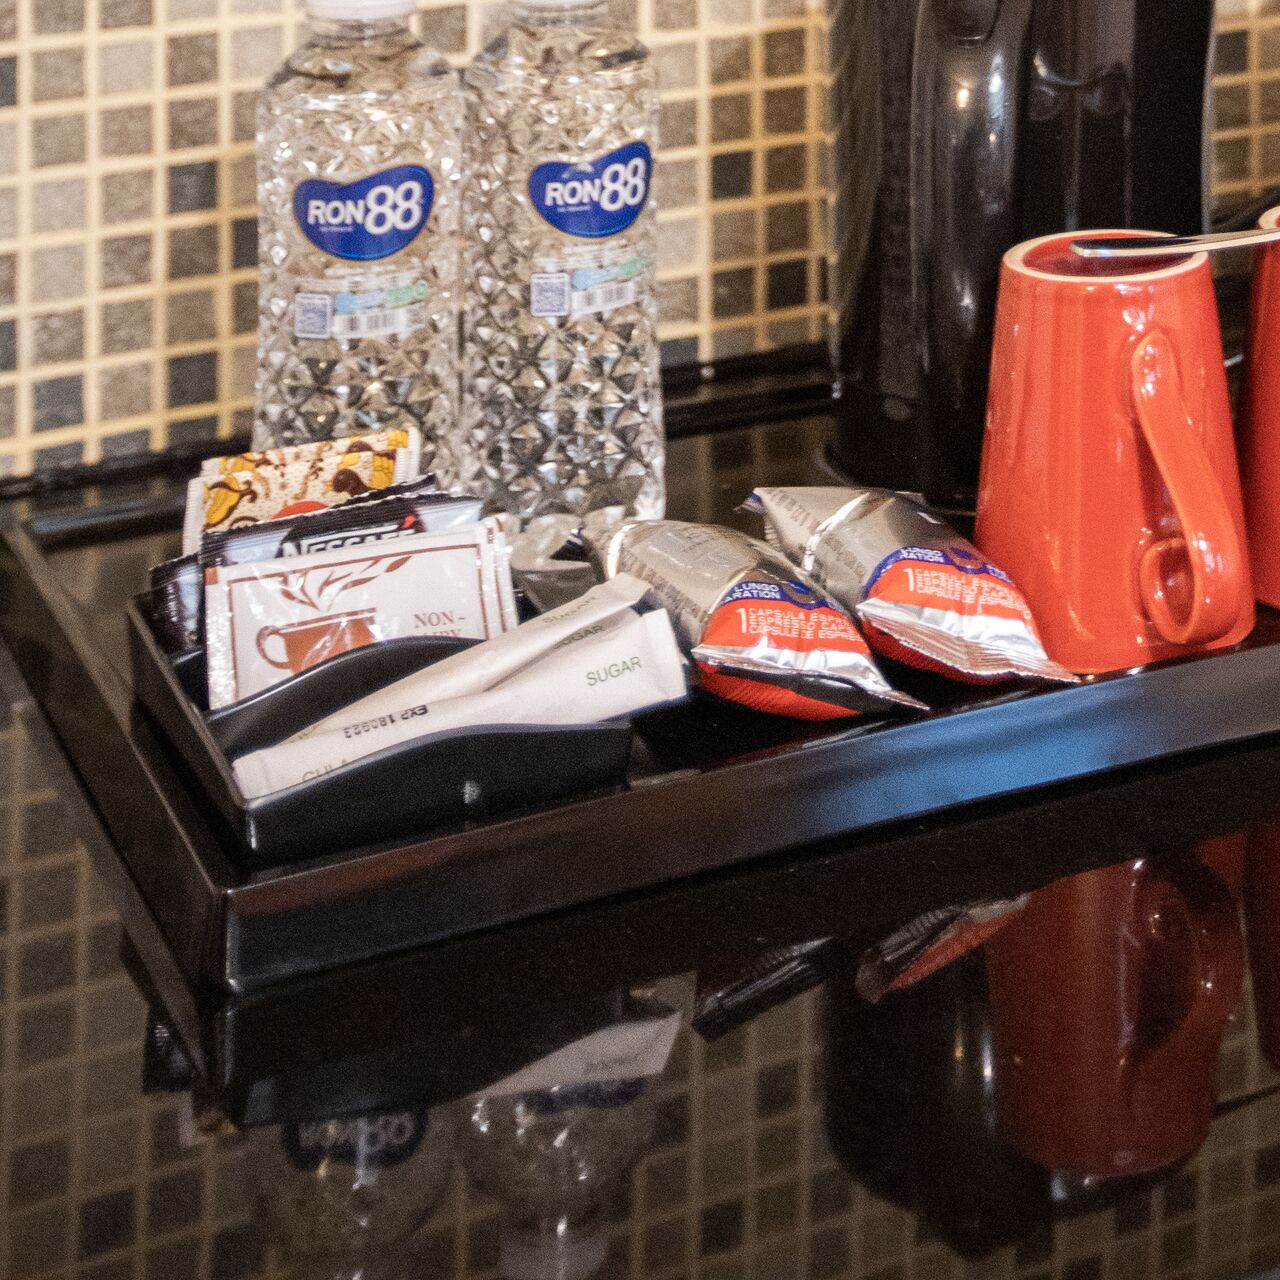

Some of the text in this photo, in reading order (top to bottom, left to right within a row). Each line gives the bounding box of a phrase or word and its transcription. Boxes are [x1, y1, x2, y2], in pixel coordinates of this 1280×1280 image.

[736, 608, 747, 633] 1
[586, 655, 643, 687] SUGAR
[401, 704, 429, 720] EXP
